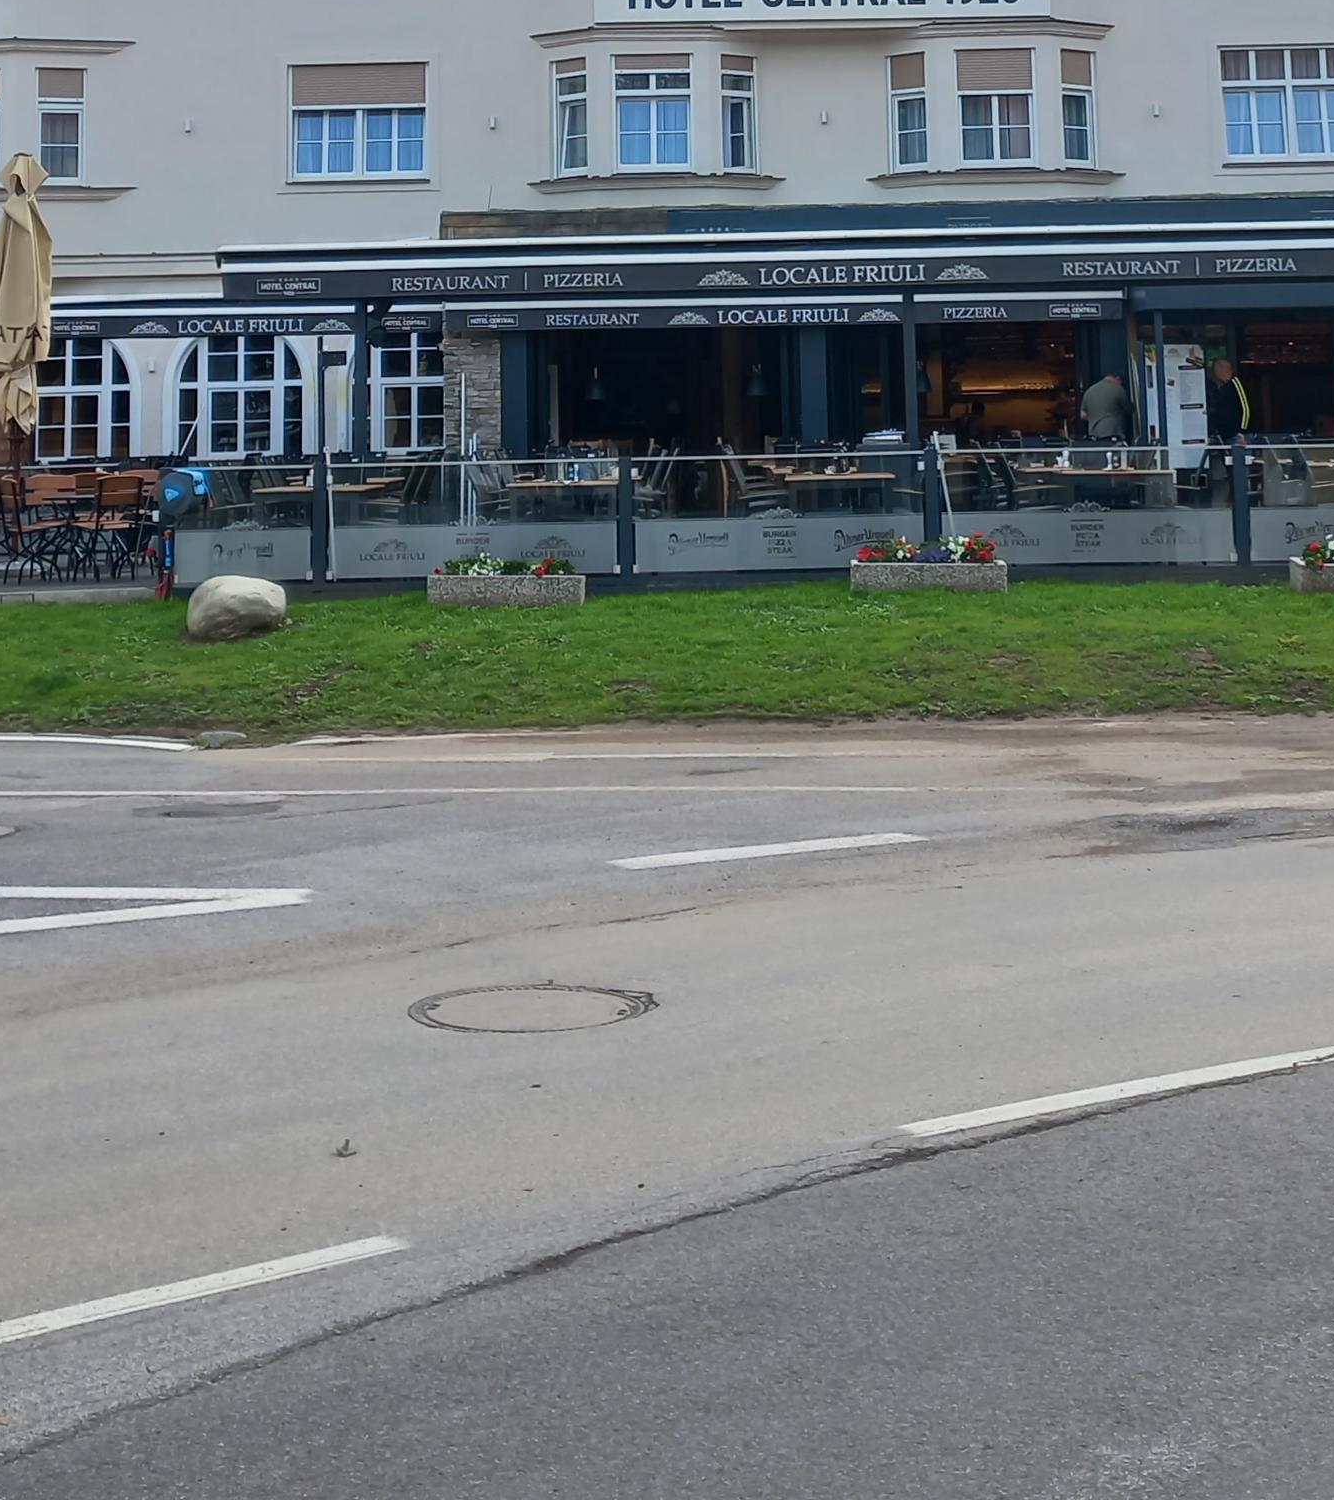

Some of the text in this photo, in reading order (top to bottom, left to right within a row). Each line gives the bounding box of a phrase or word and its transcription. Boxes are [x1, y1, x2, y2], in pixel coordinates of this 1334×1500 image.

[759, 264, 926, 286] LOCALE FRIULI
[1062, 258, 1298, 276] RESTAURANT PIZZERIA
[391, 272, 624, 292] RESTAURANT PIZZERIA
[546, 313, 640, 326] RESTAURANT
[717, 308, 850, 325] LOCALE FRIULI
[943, 306, 1008, 319] PIZZERIA
[177, 318, 304, 334] LOCALE FRIULI
[359, 552, 394, 562] LOCALE
